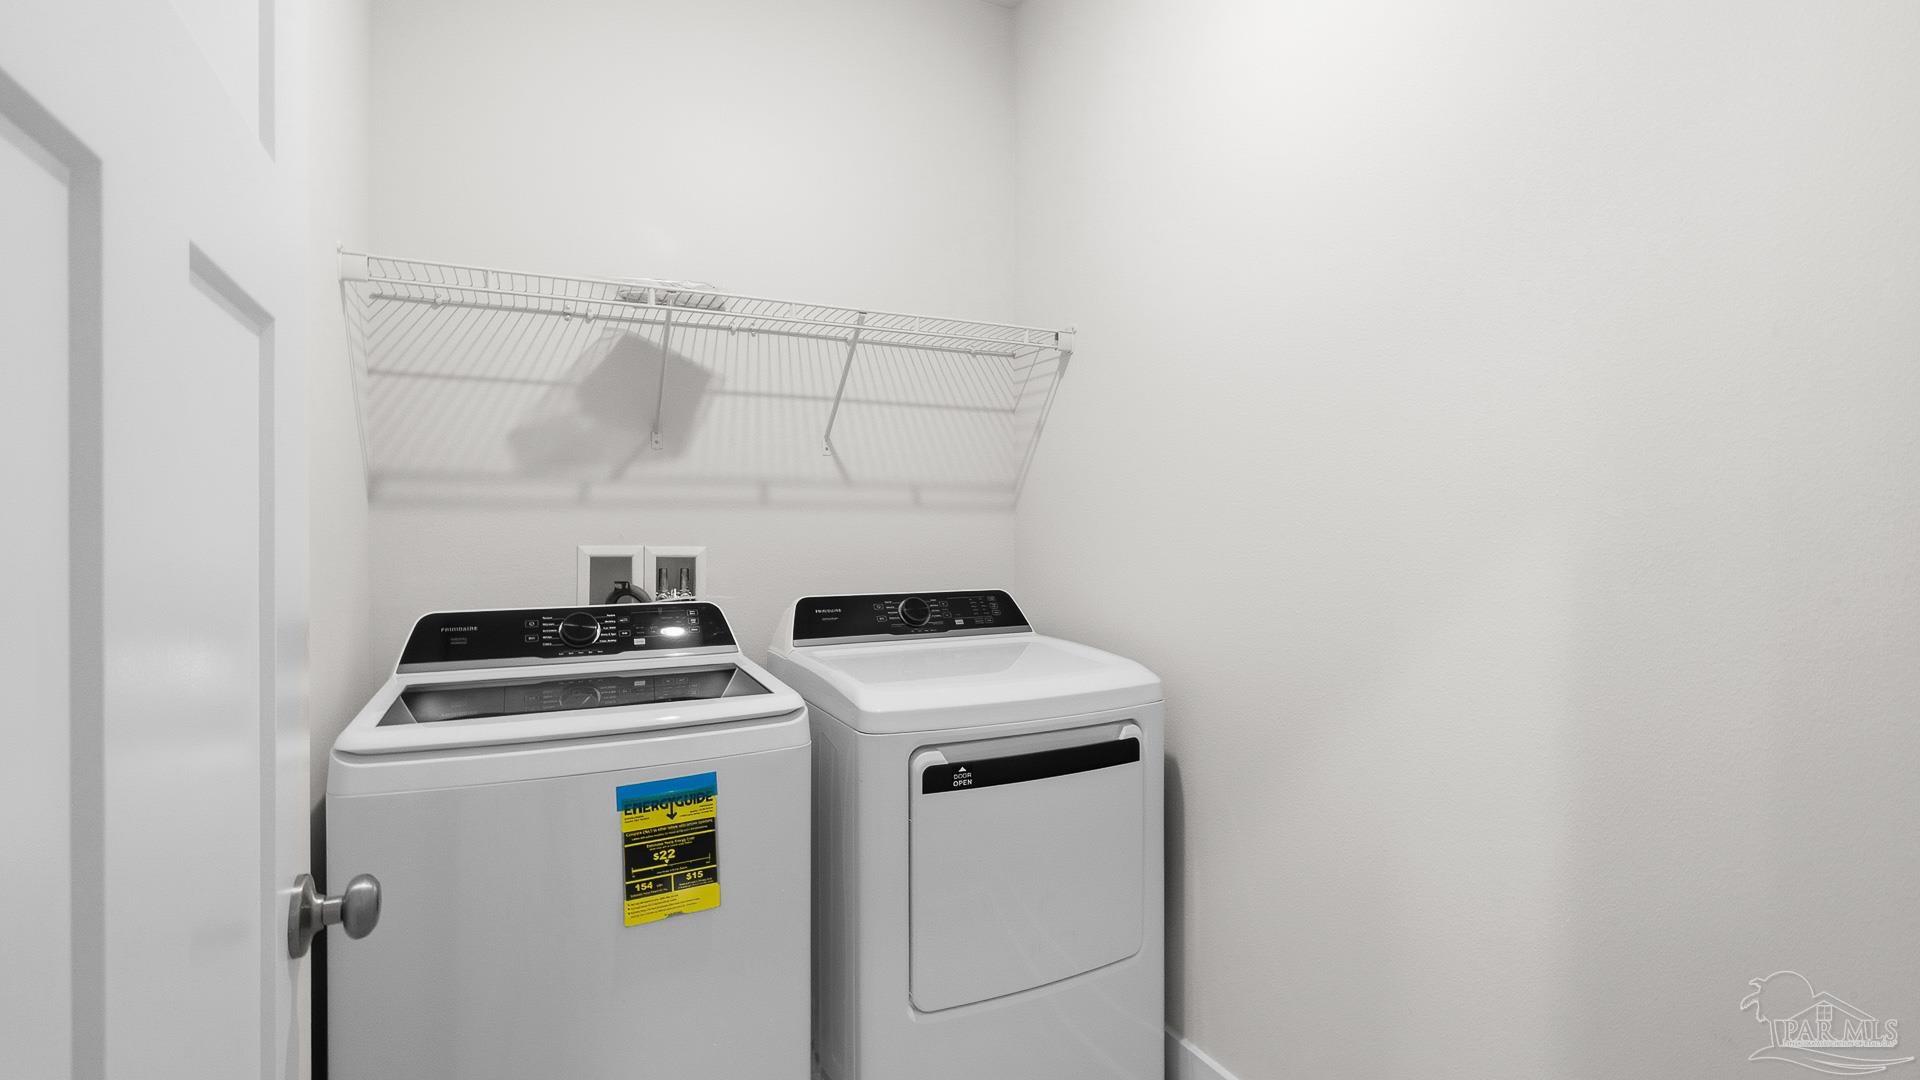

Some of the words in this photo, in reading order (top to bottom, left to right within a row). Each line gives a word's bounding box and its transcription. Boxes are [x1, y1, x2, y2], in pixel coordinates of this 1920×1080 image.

[953, 772, 972, 780] DOOR
[952, 779, 973, 787] OPEN
[652, 848, 676, 861] $22
[685, 870, 704, 881] $15
[634, 881, 653, 892] 154
